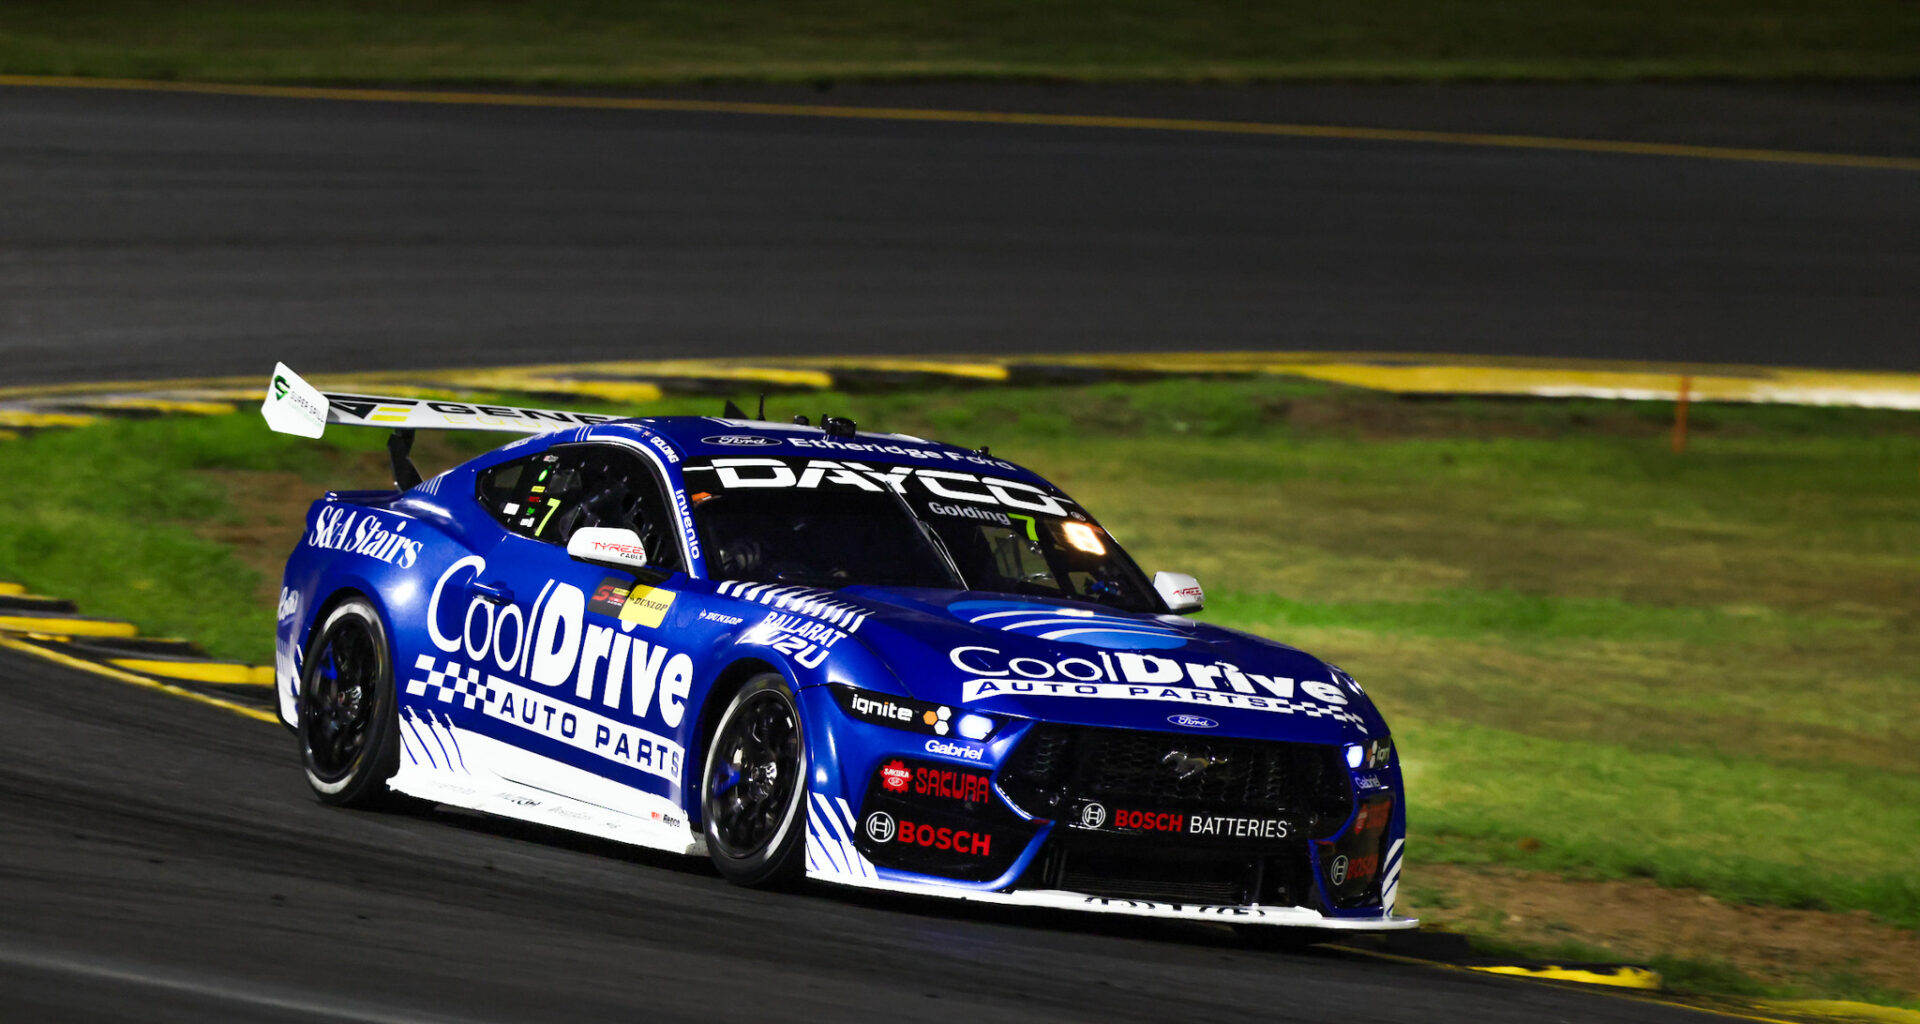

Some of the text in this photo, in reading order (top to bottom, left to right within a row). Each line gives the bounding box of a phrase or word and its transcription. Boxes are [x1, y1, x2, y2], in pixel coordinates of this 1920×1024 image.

[651, 436, 680, 463] GOLDING
[718, 436, 767, 445] Ford
[787, 437, 1018, 471] Etheridge Ford
[711, 458, 1068, 517] DAYCO
[535, 498, 561, 537] 7
[928, 501, 1011, 526] Golding
[1008, 513, 1039, 542] 7
[308, 505, 424, 569] S&A Stairs
[591, 541, 644, 555] TYREE
[633, 597, 669, 611] DUNLOP
[705, 611, 744, 625] DUNLOP
[764, 611, 848, 648] BALLARAT
[851, 693, 913, 722] ignite
[975, 681, 1270, 708] AUTO PARTS
[500, 692, 679, 778] AUTO PARTS
[1178, 716, 1210, 728] Ford
[924, 739, 984, 760] Gabriel
[884, 767, 910, 779] SAKURA
[915, 767, 990, 804] SAKURA
[1354, 775, 1381, 790] Gabriel
[1115, 809, 1288, 838] BOSCH BATTERIES
[897, 820, 992, 856] BOSCH
